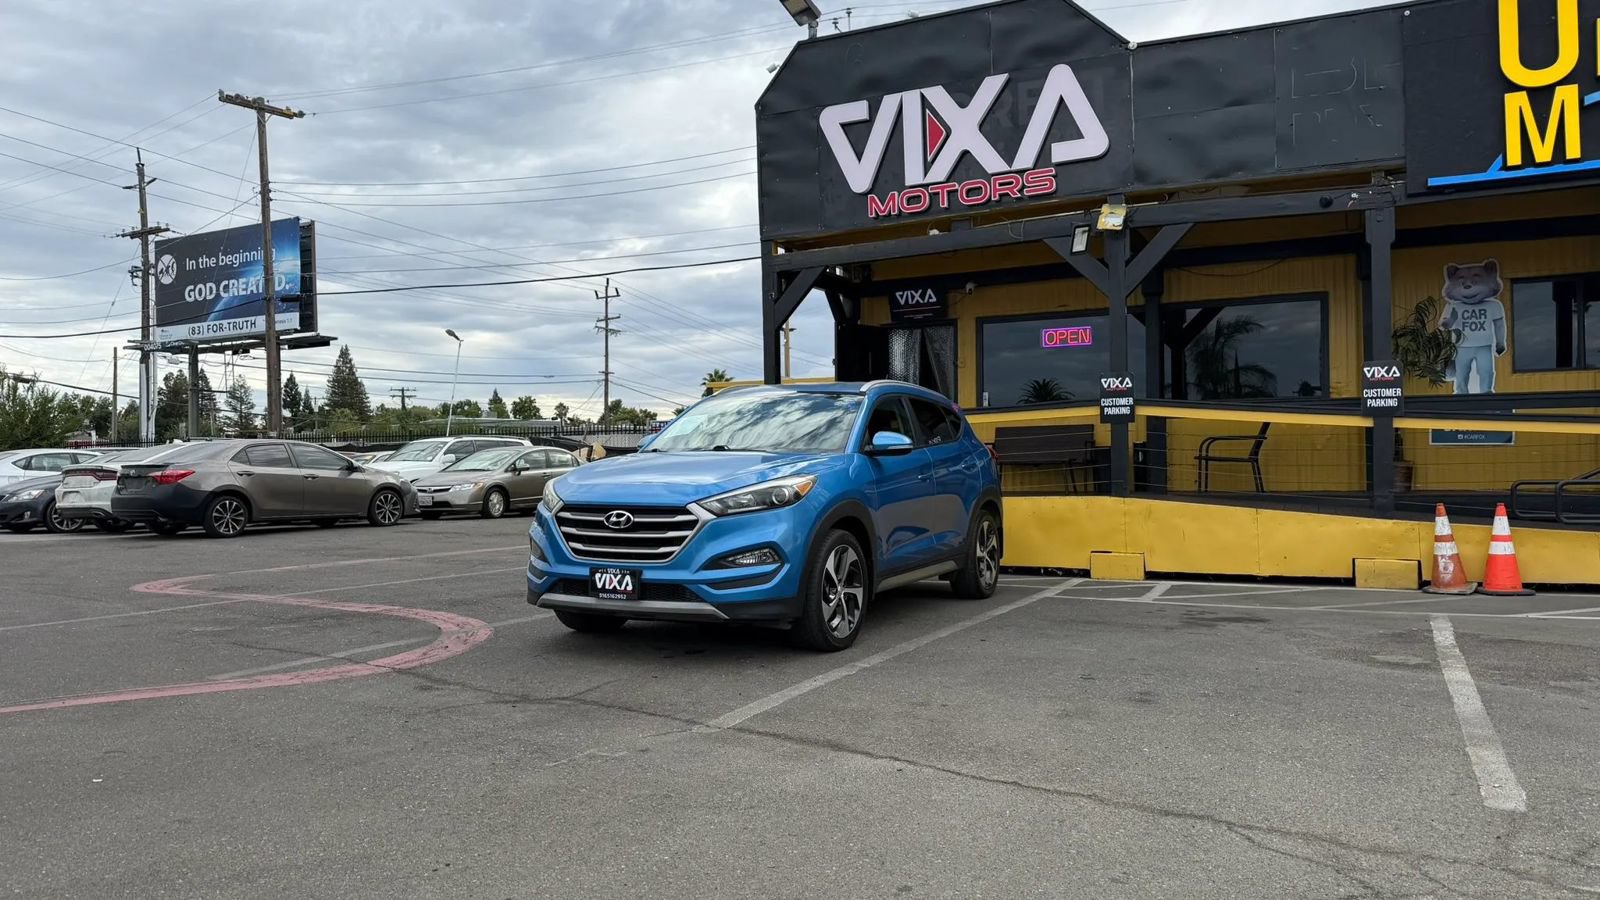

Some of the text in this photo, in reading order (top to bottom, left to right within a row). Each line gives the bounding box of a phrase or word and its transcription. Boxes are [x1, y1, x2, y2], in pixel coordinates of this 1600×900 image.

[1498, 0, 1600, 87] U
[819, 63, 1110, 194] VIXA
[867, 167, 1056, 219] MOTORS
[186, 246, 276, 271] In the beginnig
[184, 274, 289, 302] GOD CREATD.
[895, 288, 937, 305] VIXA
[1461, 308, 1487, 320] CAR
[188, 325, 205, 337] (83)
[206, 318, 257, 334] FOR-TRUTH
[1461, 321, 1486, 331] FOX
[1045, 328, 1090, 345] OPEN
[1363, 366, 1401, 377] VIXA
[1100, 377, 1133, 388] VIXA
[1363, 388, 1402, 397] CUSTOMER
[1100, 397, 1134, 406] CUSTOMER
[1367, 398, 1398, 407] PARKING
[1104, 406, 1131, 415] PARKING
[595, 573, 633, 590] VIXA
